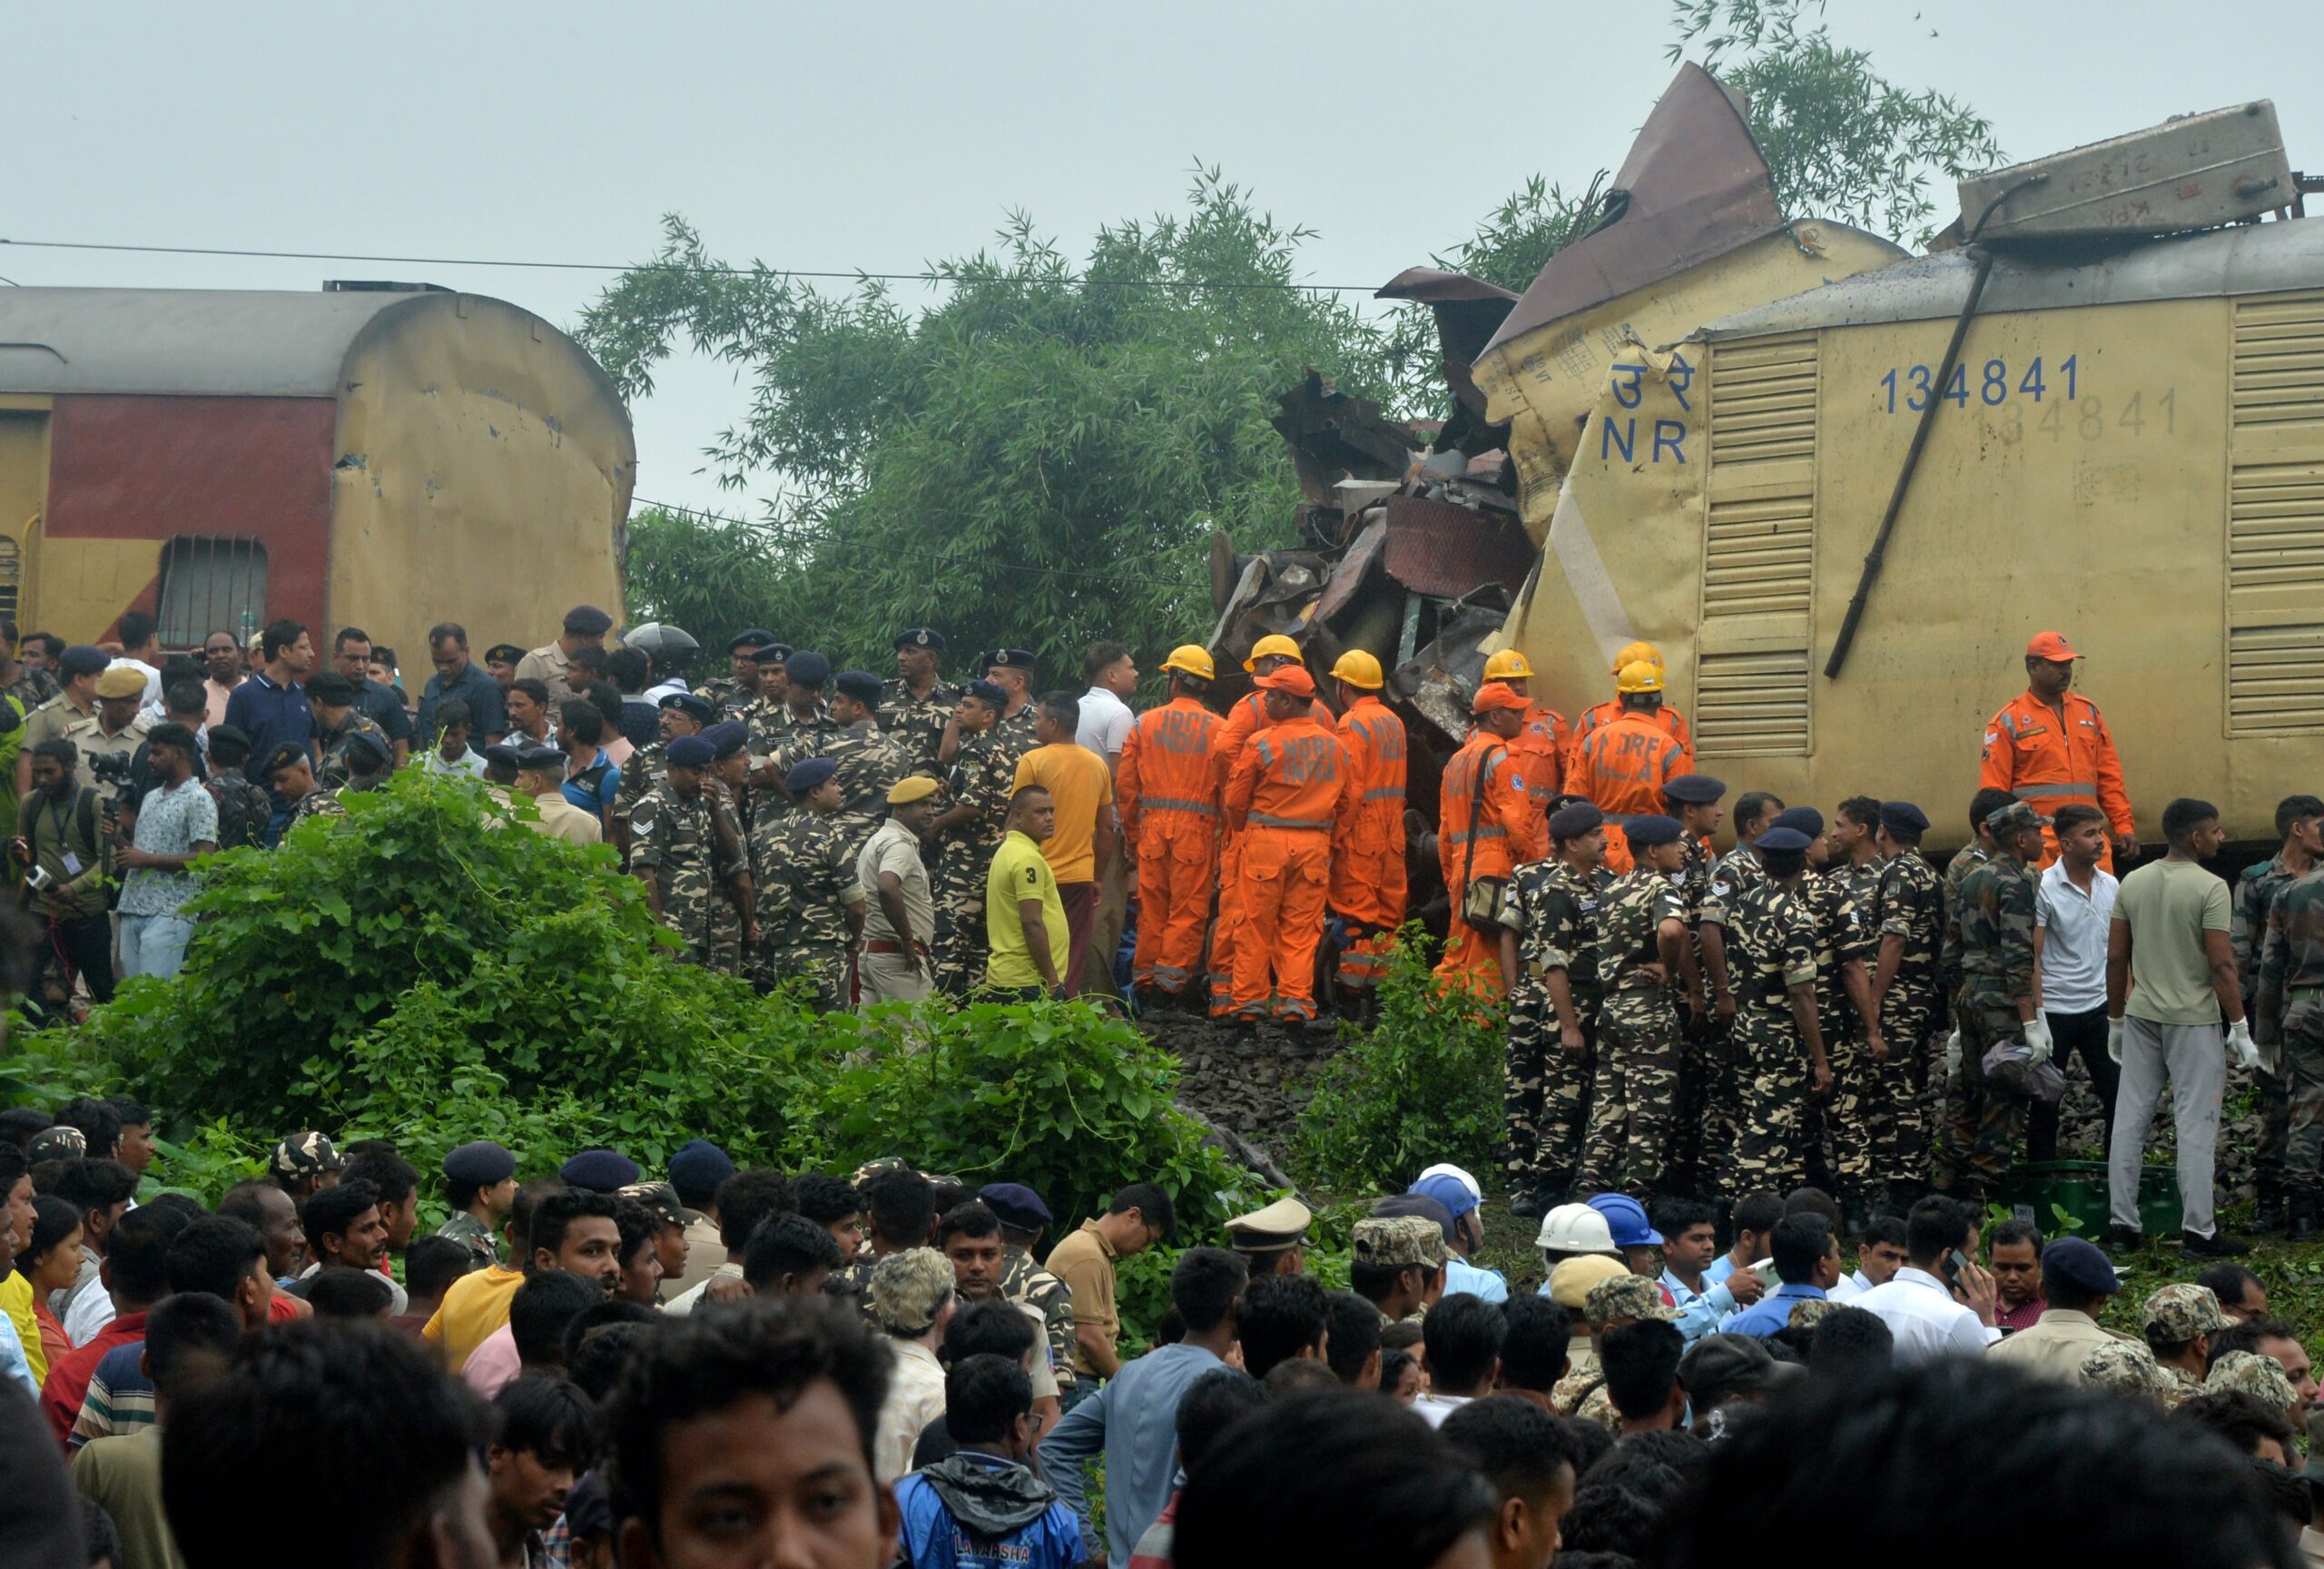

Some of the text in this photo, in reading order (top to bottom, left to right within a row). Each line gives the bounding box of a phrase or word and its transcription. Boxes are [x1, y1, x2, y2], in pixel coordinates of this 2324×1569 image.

[1880, 353, 2077, 414] 134841
[1282, 735, 1337, 762] NDRF
[1284, 758, 1334, 784] INDIA
[1026, 867, 1037, 884] 3
